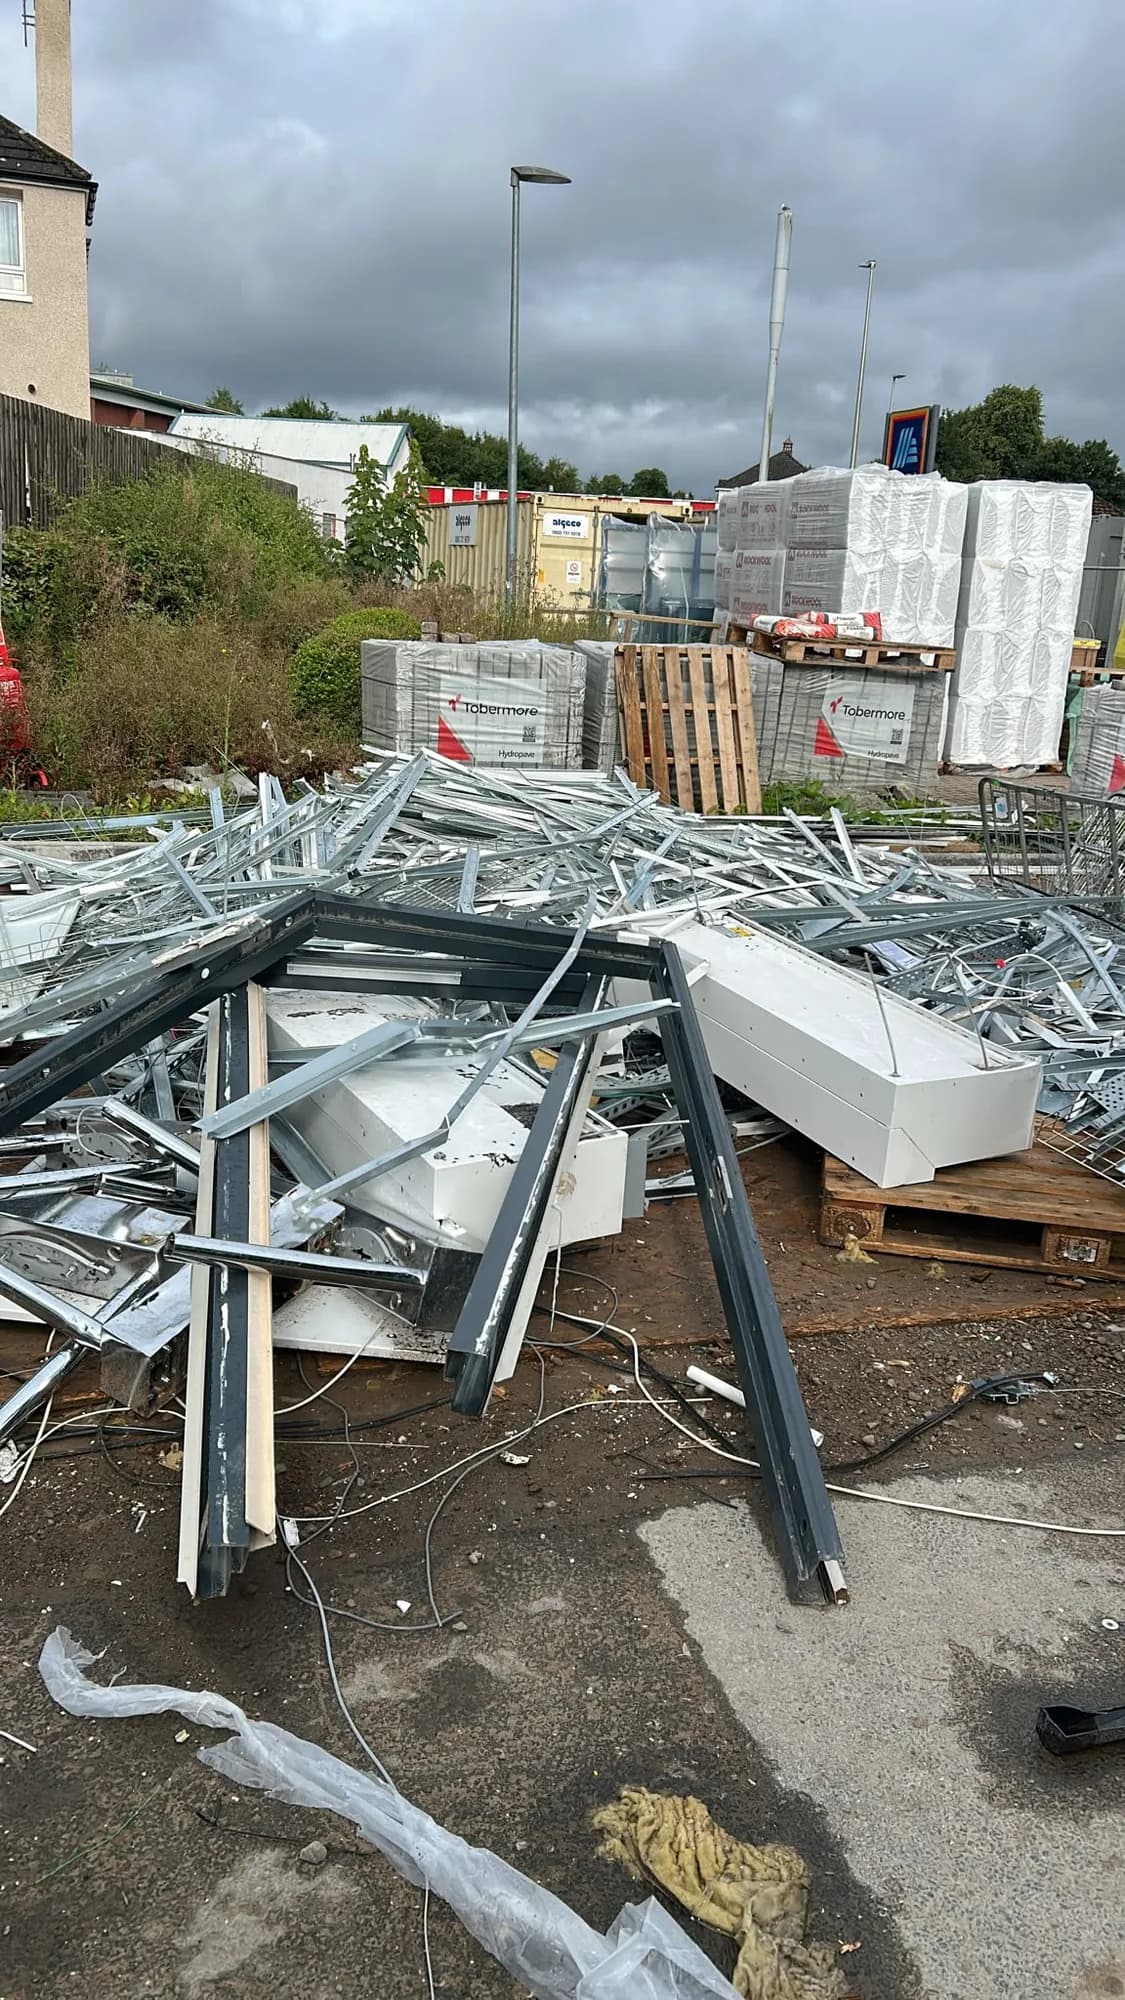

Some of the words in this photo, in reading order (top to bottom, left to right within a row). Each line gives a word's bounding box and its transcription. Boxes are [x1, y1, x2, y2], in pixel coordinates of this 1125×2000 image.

[464, 702, 538, 716] Tobermore
[843, 704, 905, 720] Tobermore
[498, 750, 535, 758] Hydropave
